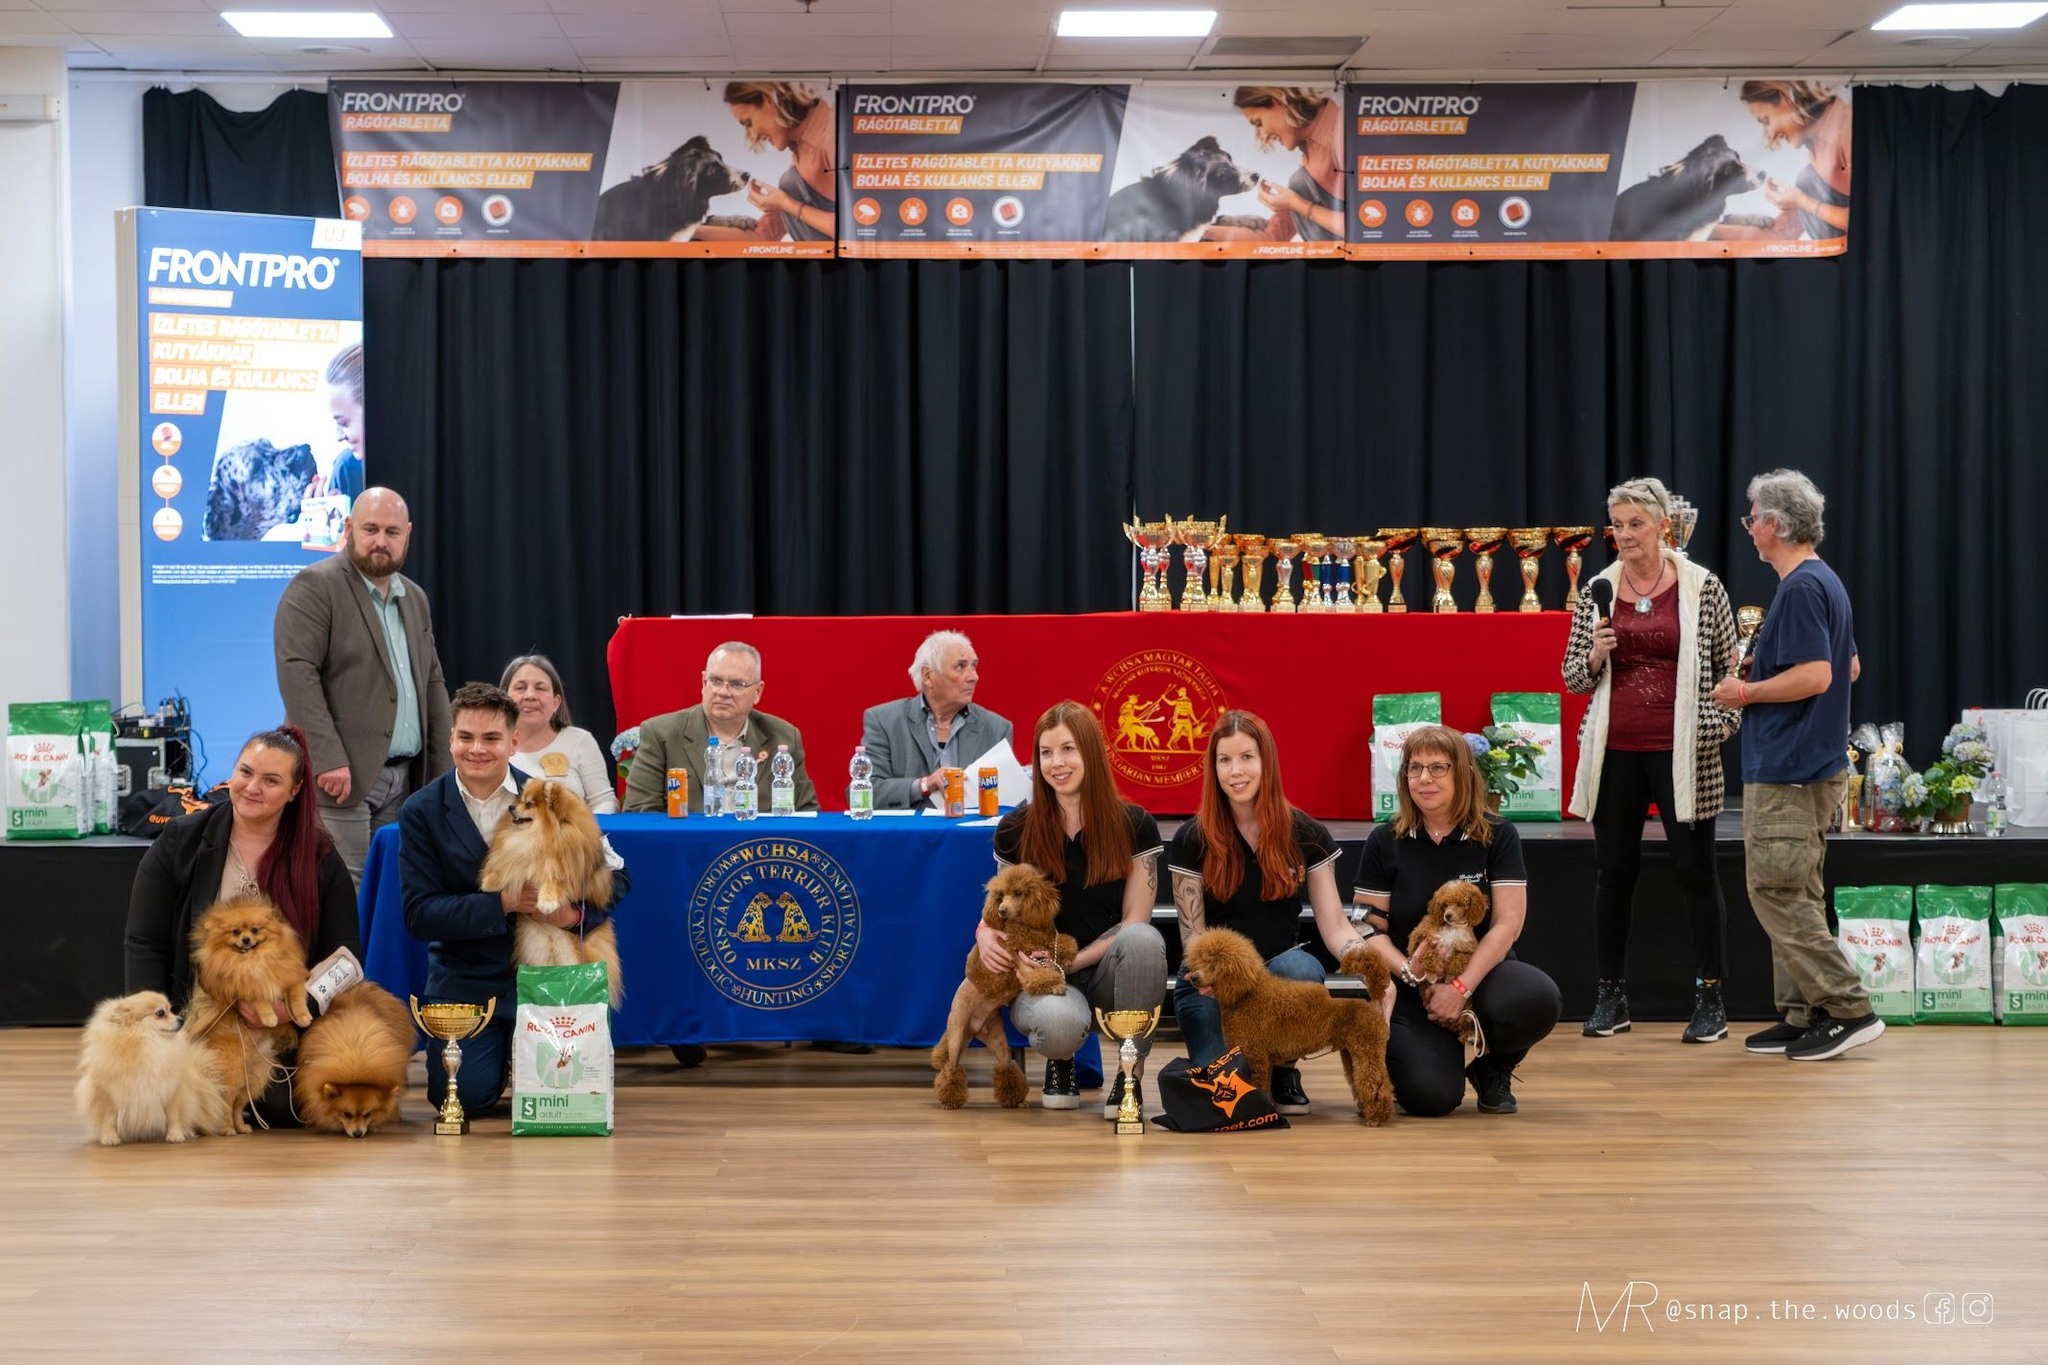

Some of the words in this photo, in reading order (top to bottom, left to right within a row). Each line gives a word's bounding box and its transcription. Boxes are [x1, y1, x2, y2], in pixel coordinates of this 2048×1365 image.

[342, 92, 463, 112] FRONTPRO
[853, 95, 974, 114] FRONTPRO
[1358, 96, 1479, 115] FRONTPRO
[346, 114, 449, 129] RÁGÓTABLETTA
[857, 116, 960, 131] RÁGÓTABLETTA
[1361, 118, 1464, 132] RÁGÓTABLETTA
[346, 153, 398, 168] ÍZLETES
[400, 152, 502, 167] RÁGÓTABLETTA
[506, 152, 588, 168] KUTYÁKNAK
[856, 155, 908, 169] ÍZLETES
[911, 154, 1013, 169] RÁGÓTABLETTA
[1017, 154, 1097, 169] KUTYÁKNAK
[1361, 156, 1413, 170] ÍZLETES
[1416, 155, 1519, 170] RÁGÓTABLETTA
[1523, 154, 1604, 170] KUTYÁKNAK
[346, 172, 390, 185] BOLHA
[394, 170, 411, 185] ÉS
[413, 172, 482, 185] KULLANCS
[487, 172, 526, 185] ELLEN
[856, 174, 900, 187] BOLHA
[904, 171, 920, 187] ÉS
[924, 174, 994, 187] KULLANCS
[997, 174, 1036, 187] ELLEN
[1361, 176, 1405, 189] BOLHA
[1409, 173, 1426, 188] ÉS
[1429, 175, 1500, 188] KULLANCS
[1503, 175, 1543, 188] ELLEN
[148, 247, 337, 291] FRONTPRO
[153, 313, 217, 338] ÍZLETES
[153, 367, 208, 388] BOLHA
[211, 365, 232, 388] ÉS
[1105, 657, 1141, 684] WCHSA
[1143, 652, 1193, 668] MAGYAR
[1383, 741, 1404, 750] ROYA
[978, 776, 998, 789] FANT
[1384, 797, 1392, 808] S
[1511, 790, 1534, 800] mini
[14, 812, 22, 825] S
[25, 807, 47, 817] mini
[739, 843, 809, 863] WCHSA
[695, 860, 733, 907] WORLD
[819, 858, 857, 929] ALLIANCE
[714, 871, 754, 964] ORSZÁGOS
[755, 864, 832, 909] TERRIER
[809, 914, 835, 965] KLUB
[692, 909, 733, 989] CYNOLOGIC
[1875, 938, 1903, 947] CANIN
[1924, 936, 1951, 944] ROYAL
[746, 958, 801, 971] MKSZ
[820, 931, 855, 983] SPORTS
[741, 983, 813, 1005] HUNTING
[1924, 995, 1934, 1007] S
[1937, 989, 1962, 999] mini
[2012, 996, 2021, 1008] S
[527, 1021, 560, 1038] ROA
[562, 1022, 596, 1039] CANIN
[524, 1101, 534, 1116] S
[539, 1094, 569, 1107] mini
